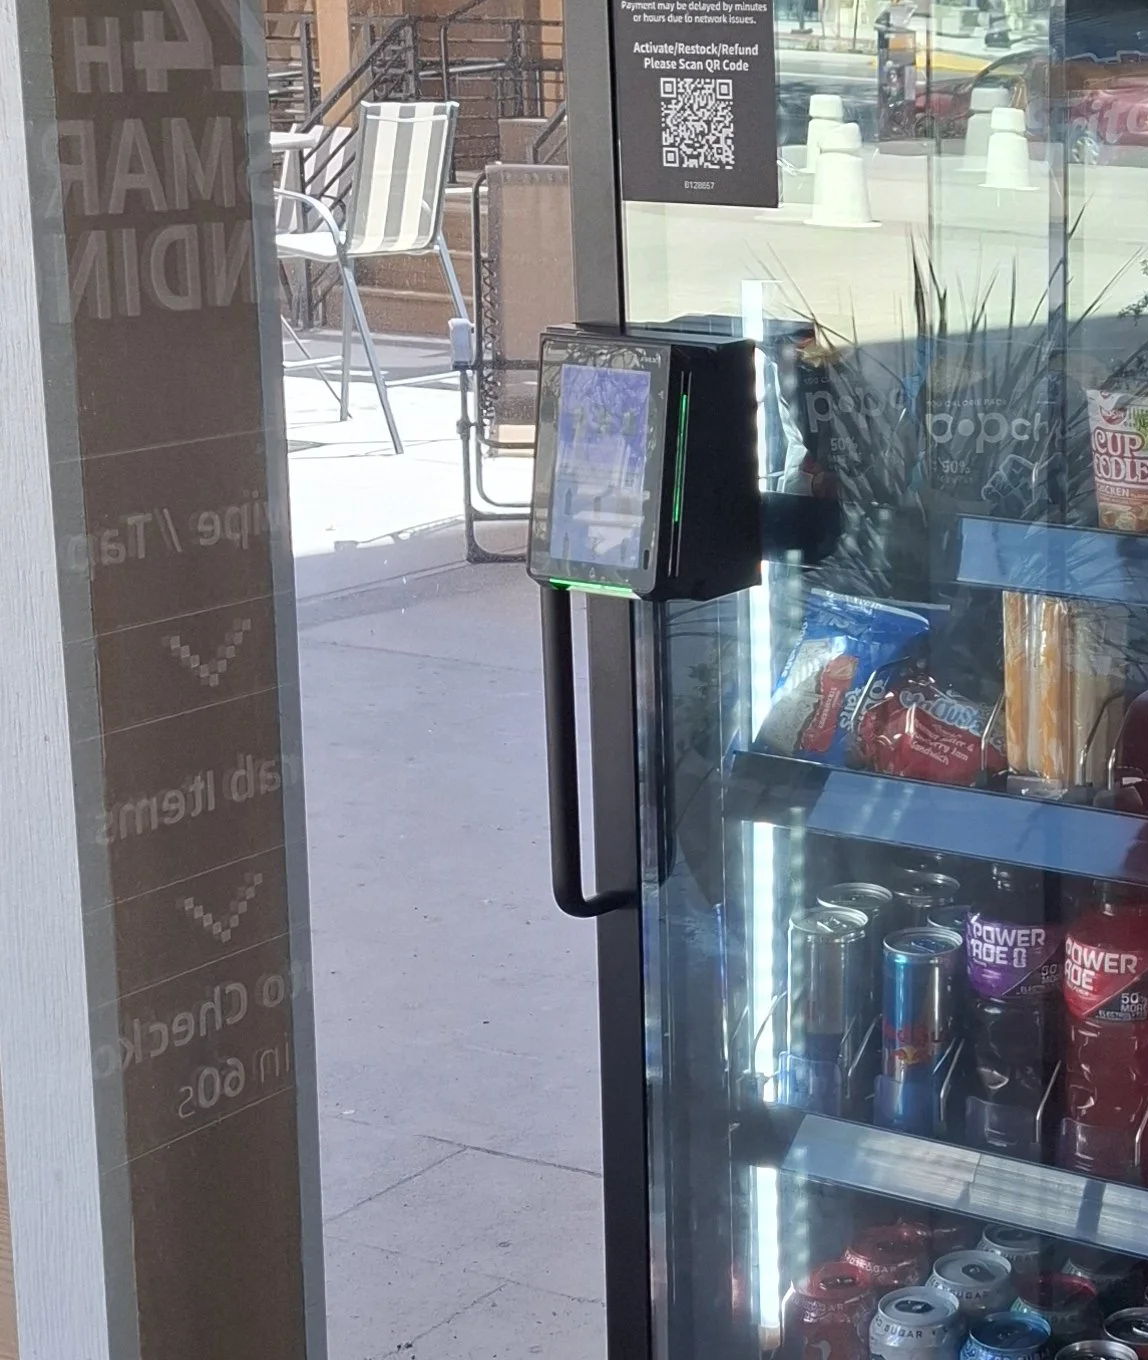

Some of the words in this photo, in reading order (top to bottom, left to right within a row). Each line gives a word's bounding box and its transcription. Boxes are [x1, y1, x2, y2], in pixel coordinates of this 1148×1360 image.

[621, 1, 656, 12] Payment
[658, 2, 674, 12] may
[676, 1, 687, 10] be
[689, 1, 721, 12] delayed
[723, 2, 732, 12] by
[735, 2, 767, 12] minutes
[643, 13, 665, 23] hours
[668, 14, 683, 23] due
[695, 15, 727, 23] network
[729, 14, 756, 24] issues.
[633, 42, 758, 57] Activate/Restock/Refund
[644, 57, 676, 70] Please
[679, 59, 703, 70] Scan
[706, 59, 720, 72] QR
[723, 59, 749, 71] Code
[1093, 428, 1145, 457] CUP
[972, 922, 1045, 947] POWER
[971, 939, 1008, 965] ADE
[1065, 938, 1138, 974] POWER
[1064, 959, 1095, 990] ADE
[883, 1324, 923, 1339] SUGAR
